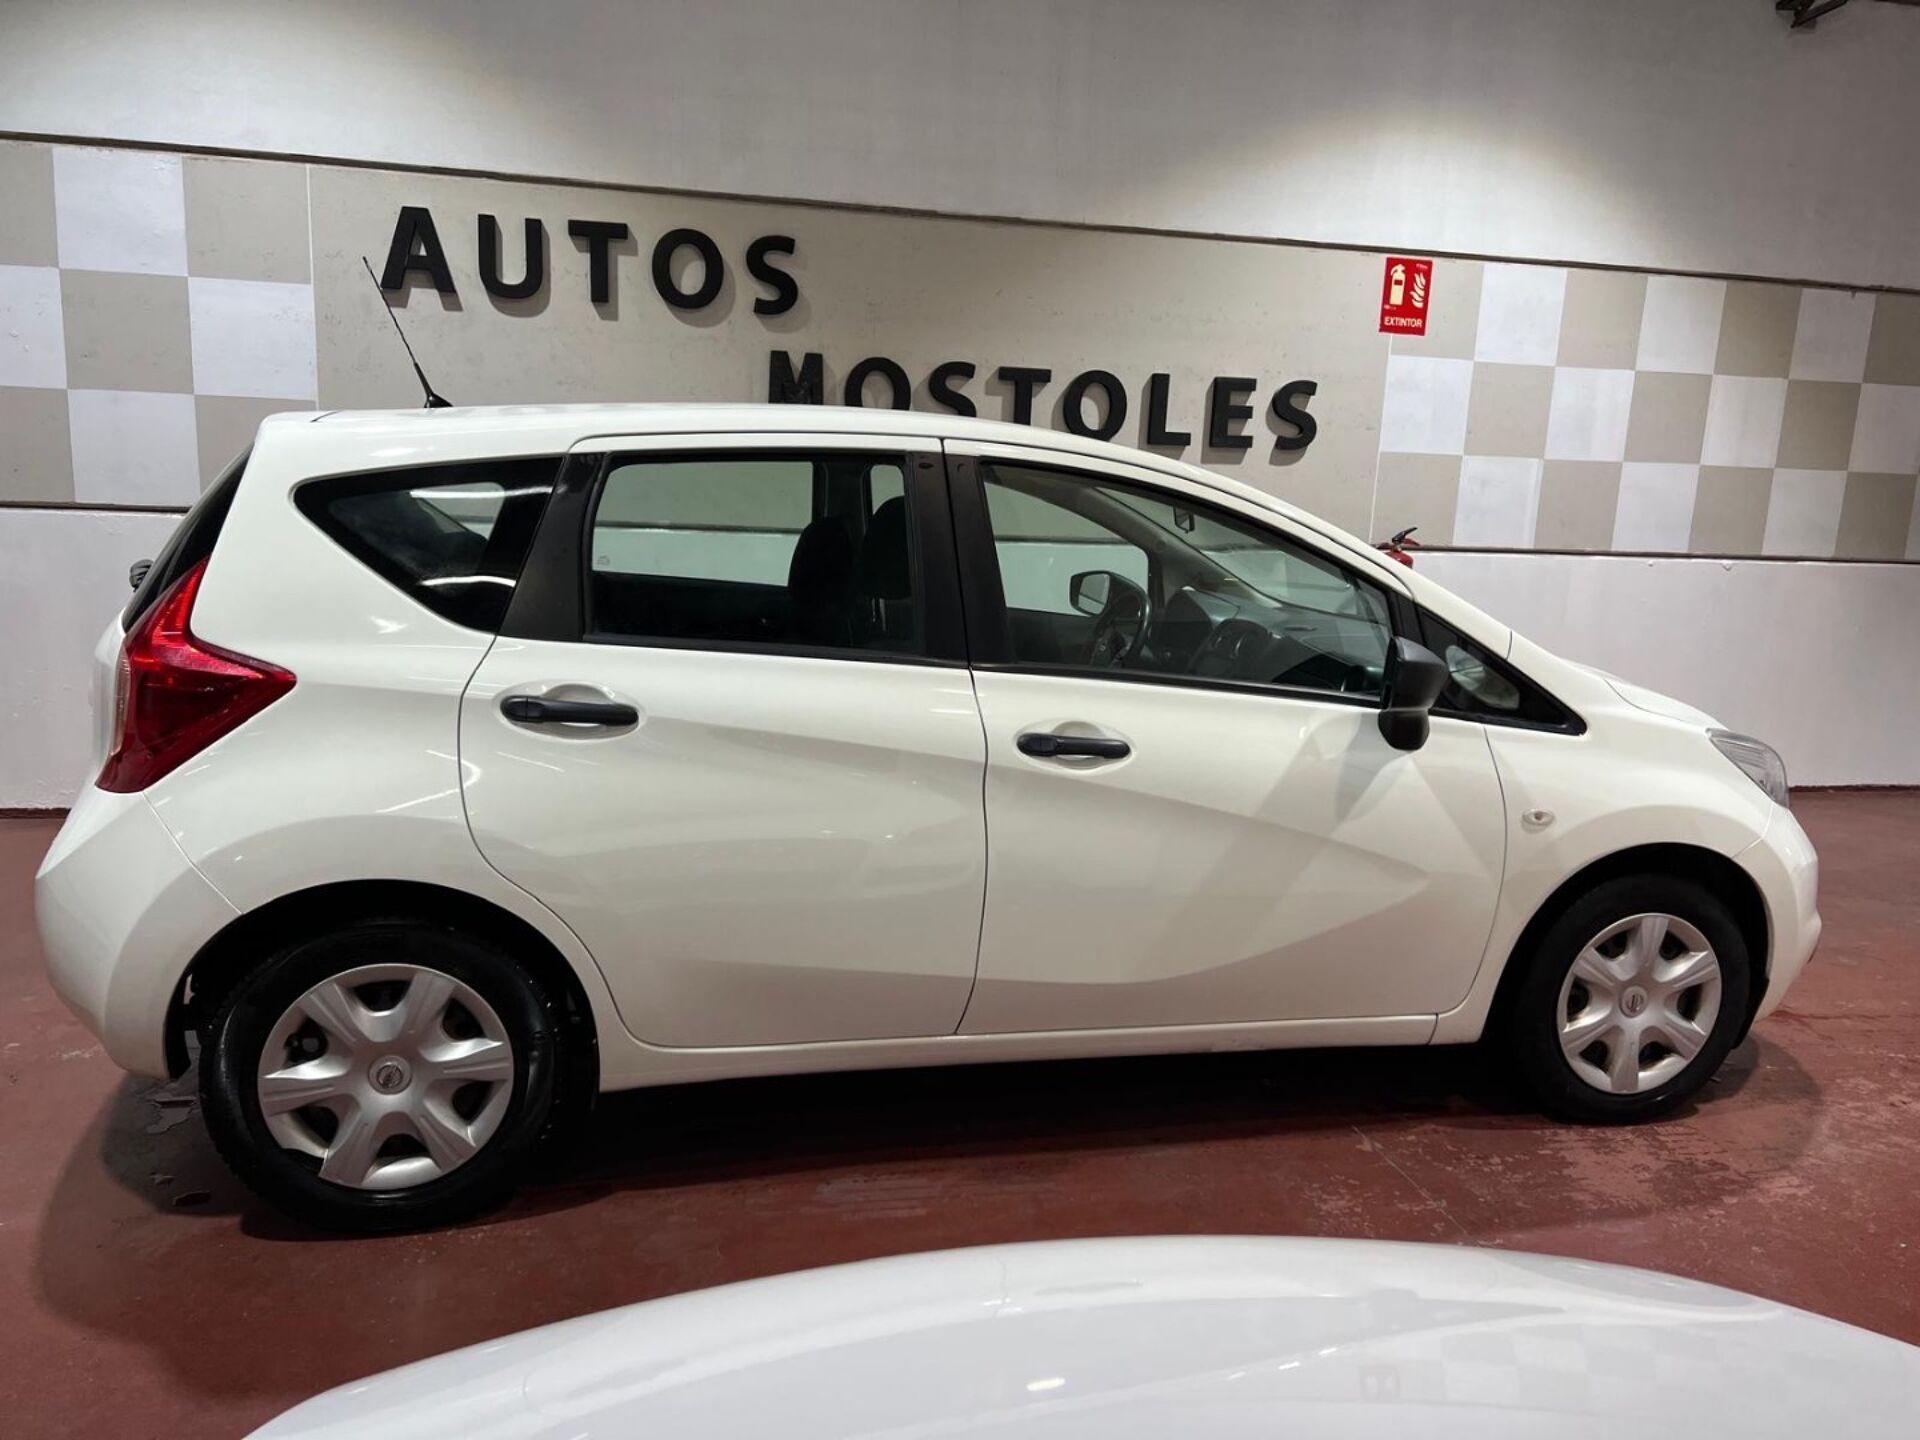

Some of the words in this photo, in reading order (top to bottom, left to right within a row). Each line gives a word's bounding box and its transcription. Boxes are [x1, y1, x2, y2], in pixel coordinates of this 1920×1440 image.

[381, 206, 799, 315] AUTOS
[1384, 316, 1423, 328] EXTINTOR
[768, 350, 1319, 451] MOSTOLES
